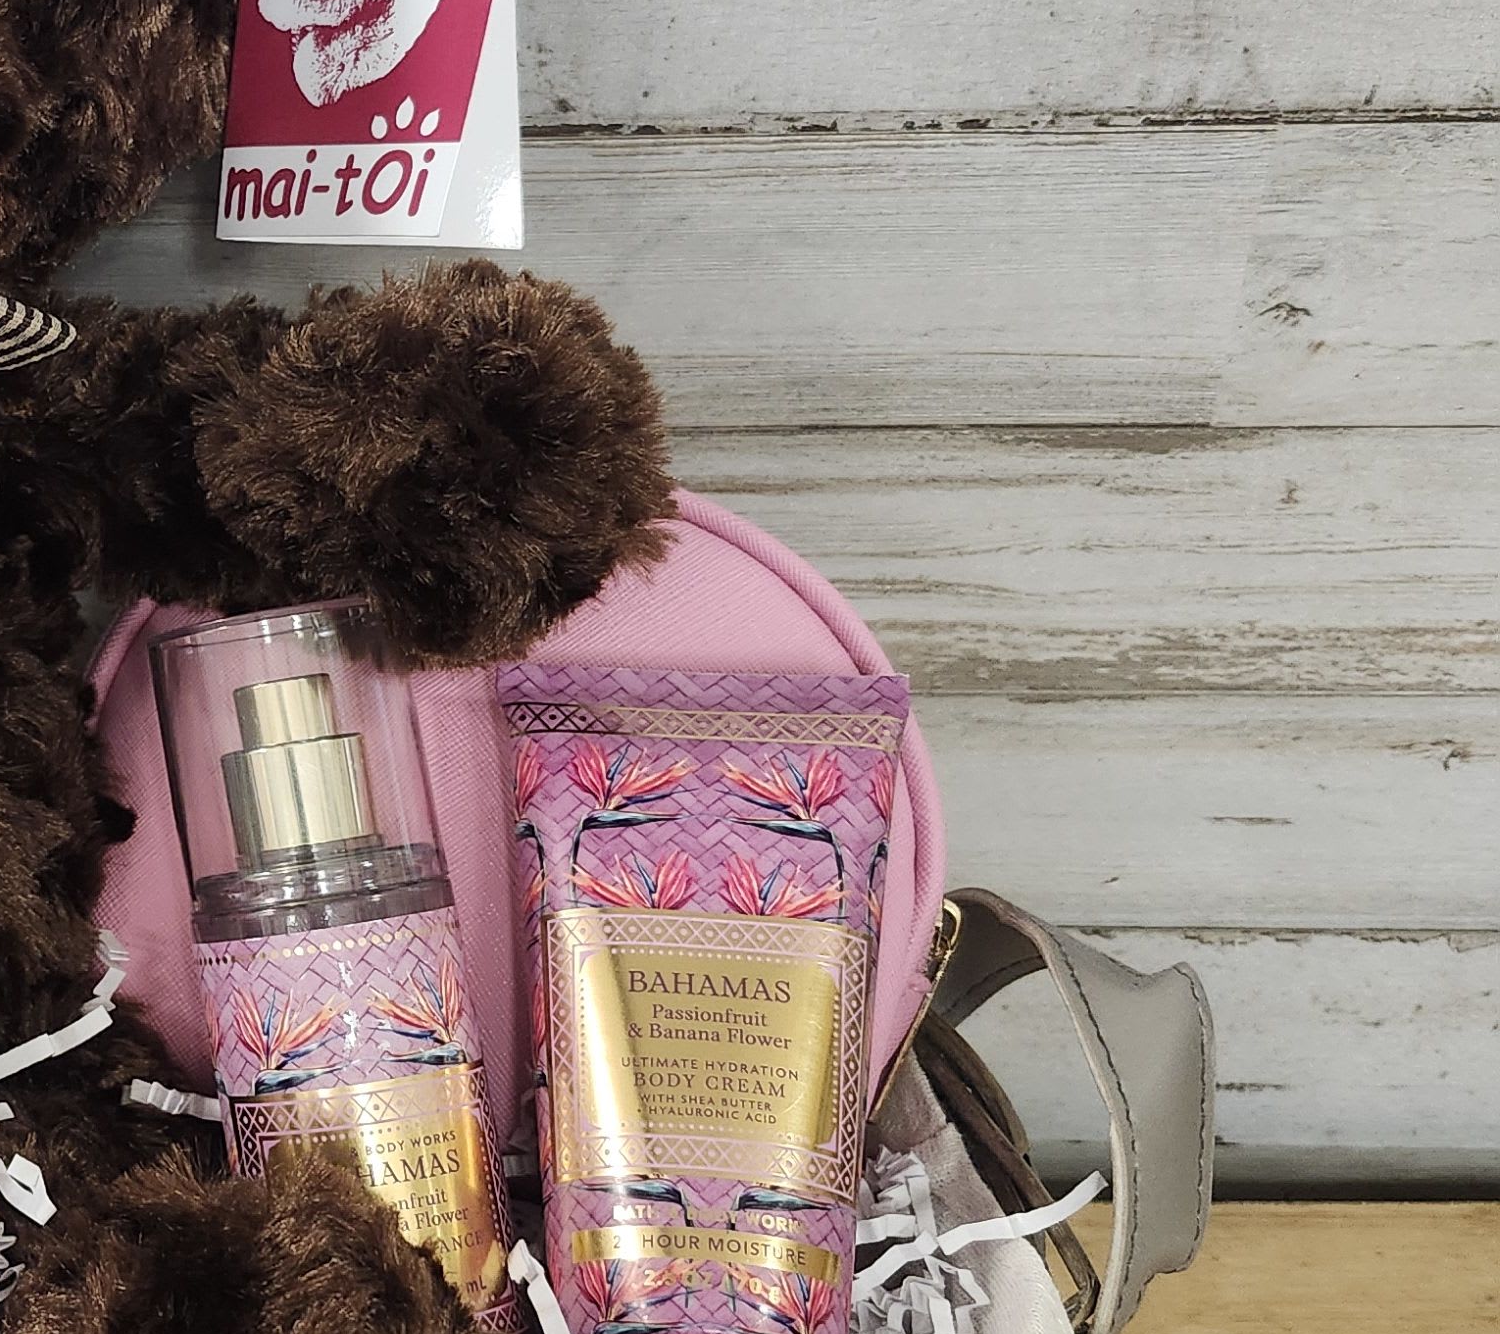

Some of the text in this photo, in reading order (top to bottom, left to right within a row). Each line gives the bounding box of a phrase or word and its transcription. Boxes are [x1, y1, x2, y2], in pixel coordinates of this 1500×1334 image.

[628, 970, 791, 1003] BAHAMAS
[652, 1003, 768, 1027] Passionfruit
[627, 1022, 792, 1049] & Banana Flower
[621, 1056, 799, 1081] ULTIMATE HYDRATION
[633, 1071, 786, 1098] BODY CREAM
[639, 1093, 772, 1111] WITH SHEA BUTTER
[649, 1106, 739, 1120] HYALURONIC
[745, 1113, 777, 1124] ACID
[365, 1139, 404, 1156] BODY
[411, 1130, 456, 1148] WORKS
[356, 1148, 460, 1187] HAMAS
[389, 1188, 448, 1211] onfruit
[414, 1207, 468, 1229] Flower
[746, 1212, 808, 1236] WOR
[642, 1234, 700, 1250] HOUR
[708, 1238, 806, 1265] MOISTURE
